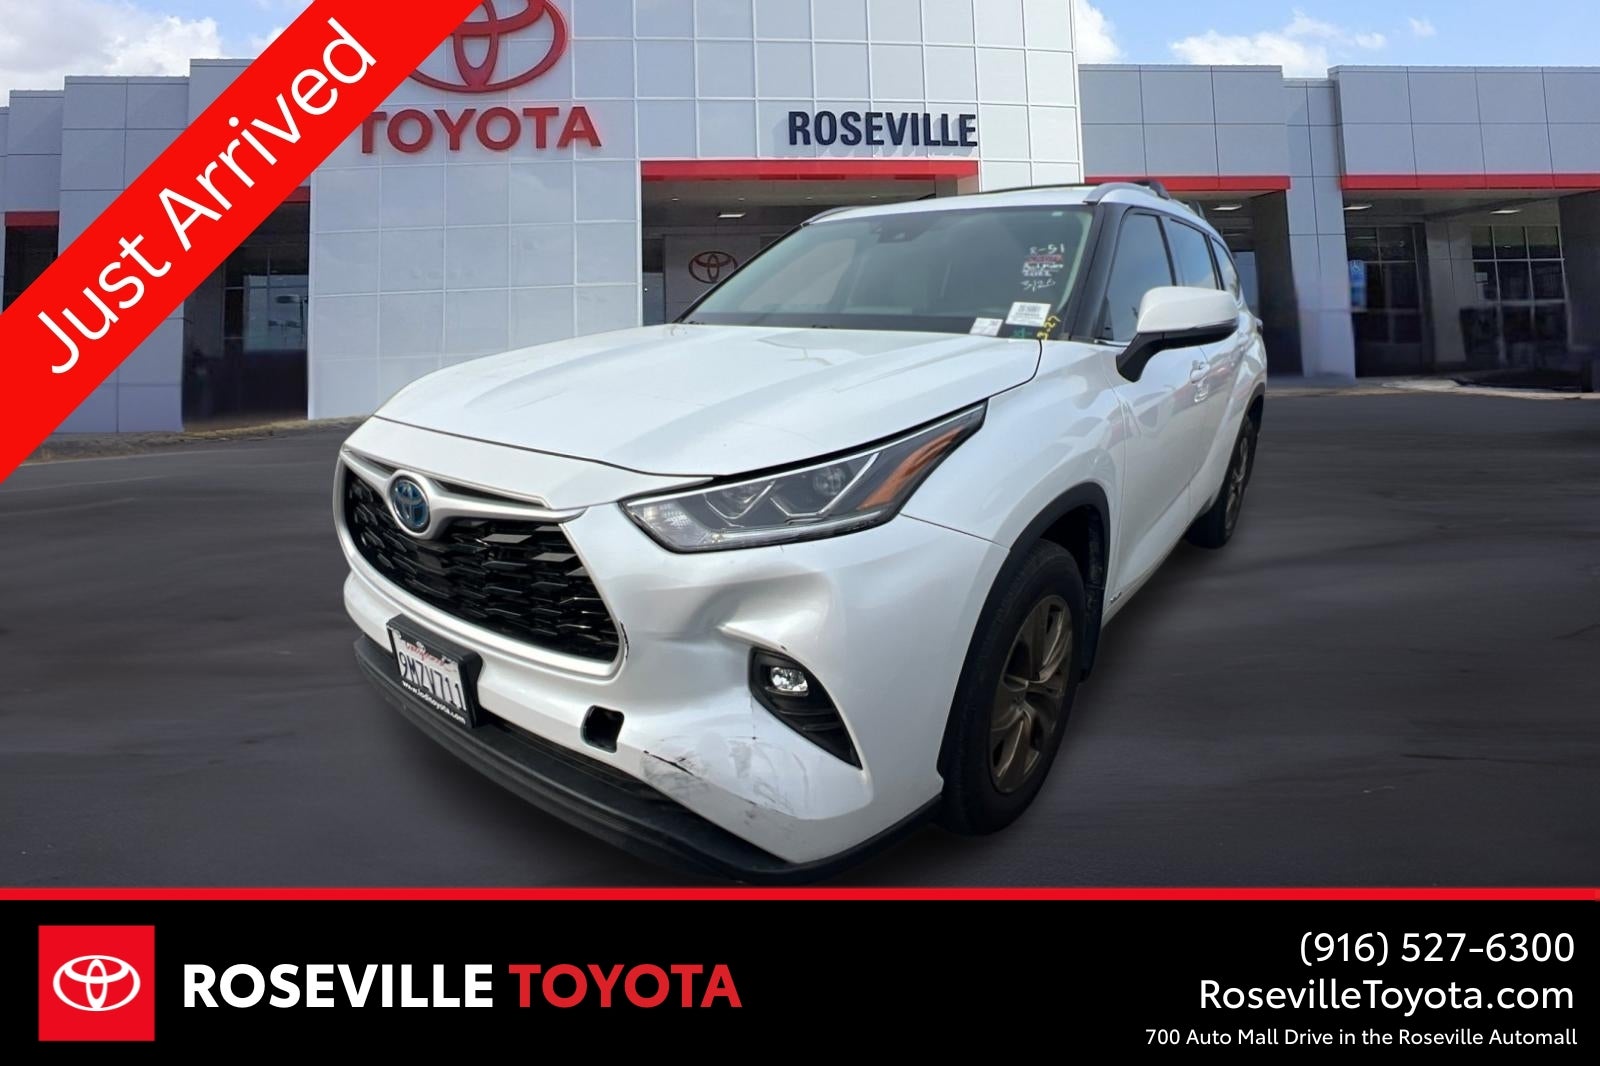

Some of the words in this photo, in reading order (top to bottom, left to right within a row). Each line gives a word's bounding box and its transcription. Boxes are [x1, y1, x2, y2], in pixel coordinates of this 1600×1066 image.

[361, 105, 602, 154] TOYOTA
[788, 110, 978, 147] ROSEVILLE
[399, 651, 467, 711] 9MZV711
